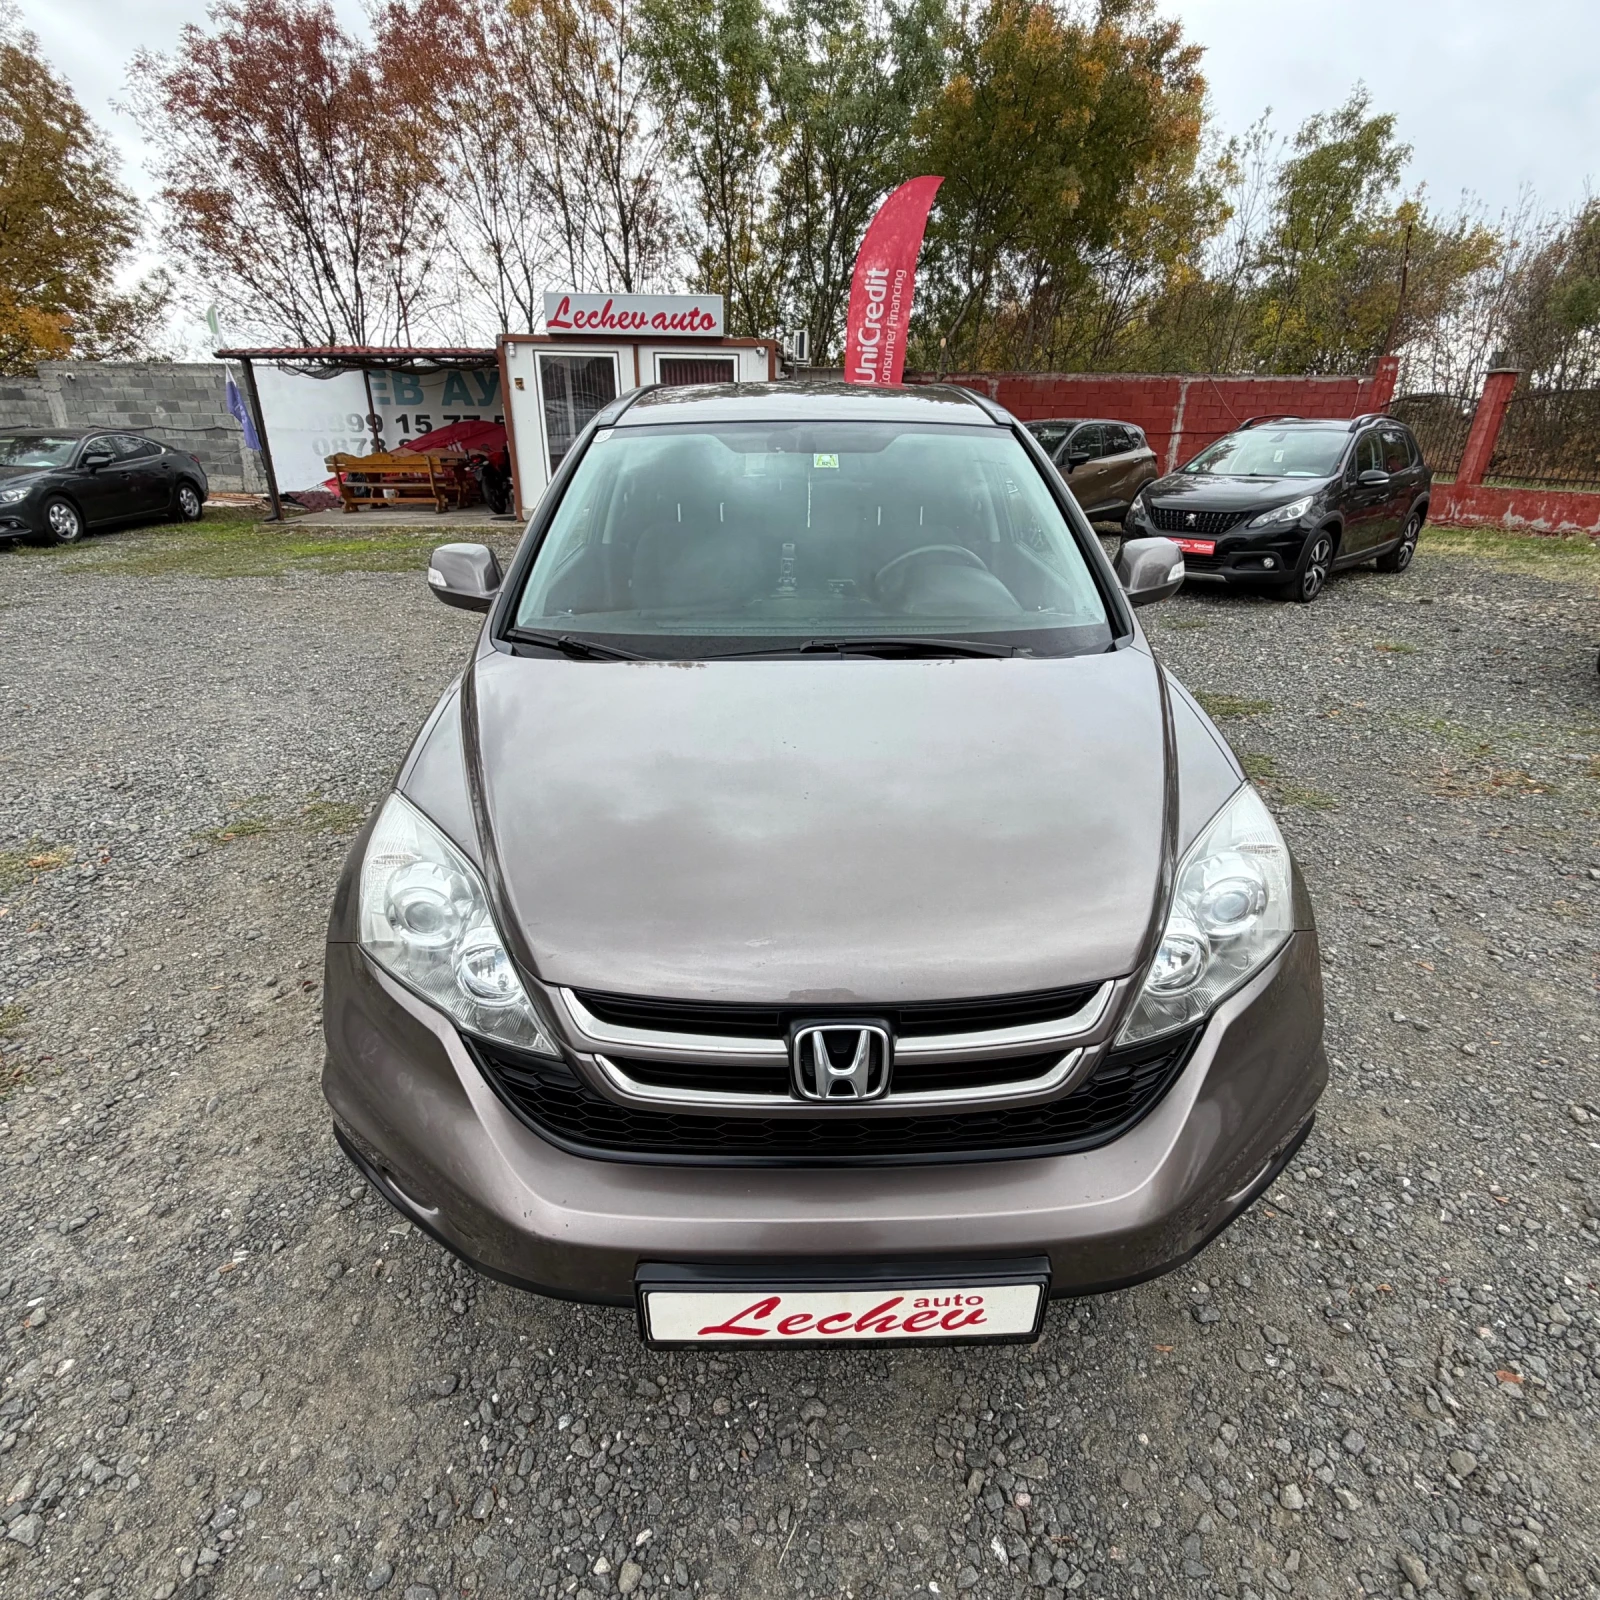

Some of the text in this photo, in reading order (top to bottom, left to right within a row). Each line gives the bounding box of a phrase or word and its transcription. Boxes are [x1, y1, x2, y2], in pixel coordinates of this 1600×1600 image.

[547, 296, 717, 331] Lechev auto
[854, 267, 889, 384] UniCredit
[879, 269, 907, 384] onsumer Financing
[395, 413, 433, 434] 15
[697, 1296, 988, 1336] Lechev
[913, 1294, 984, 1308] auto
